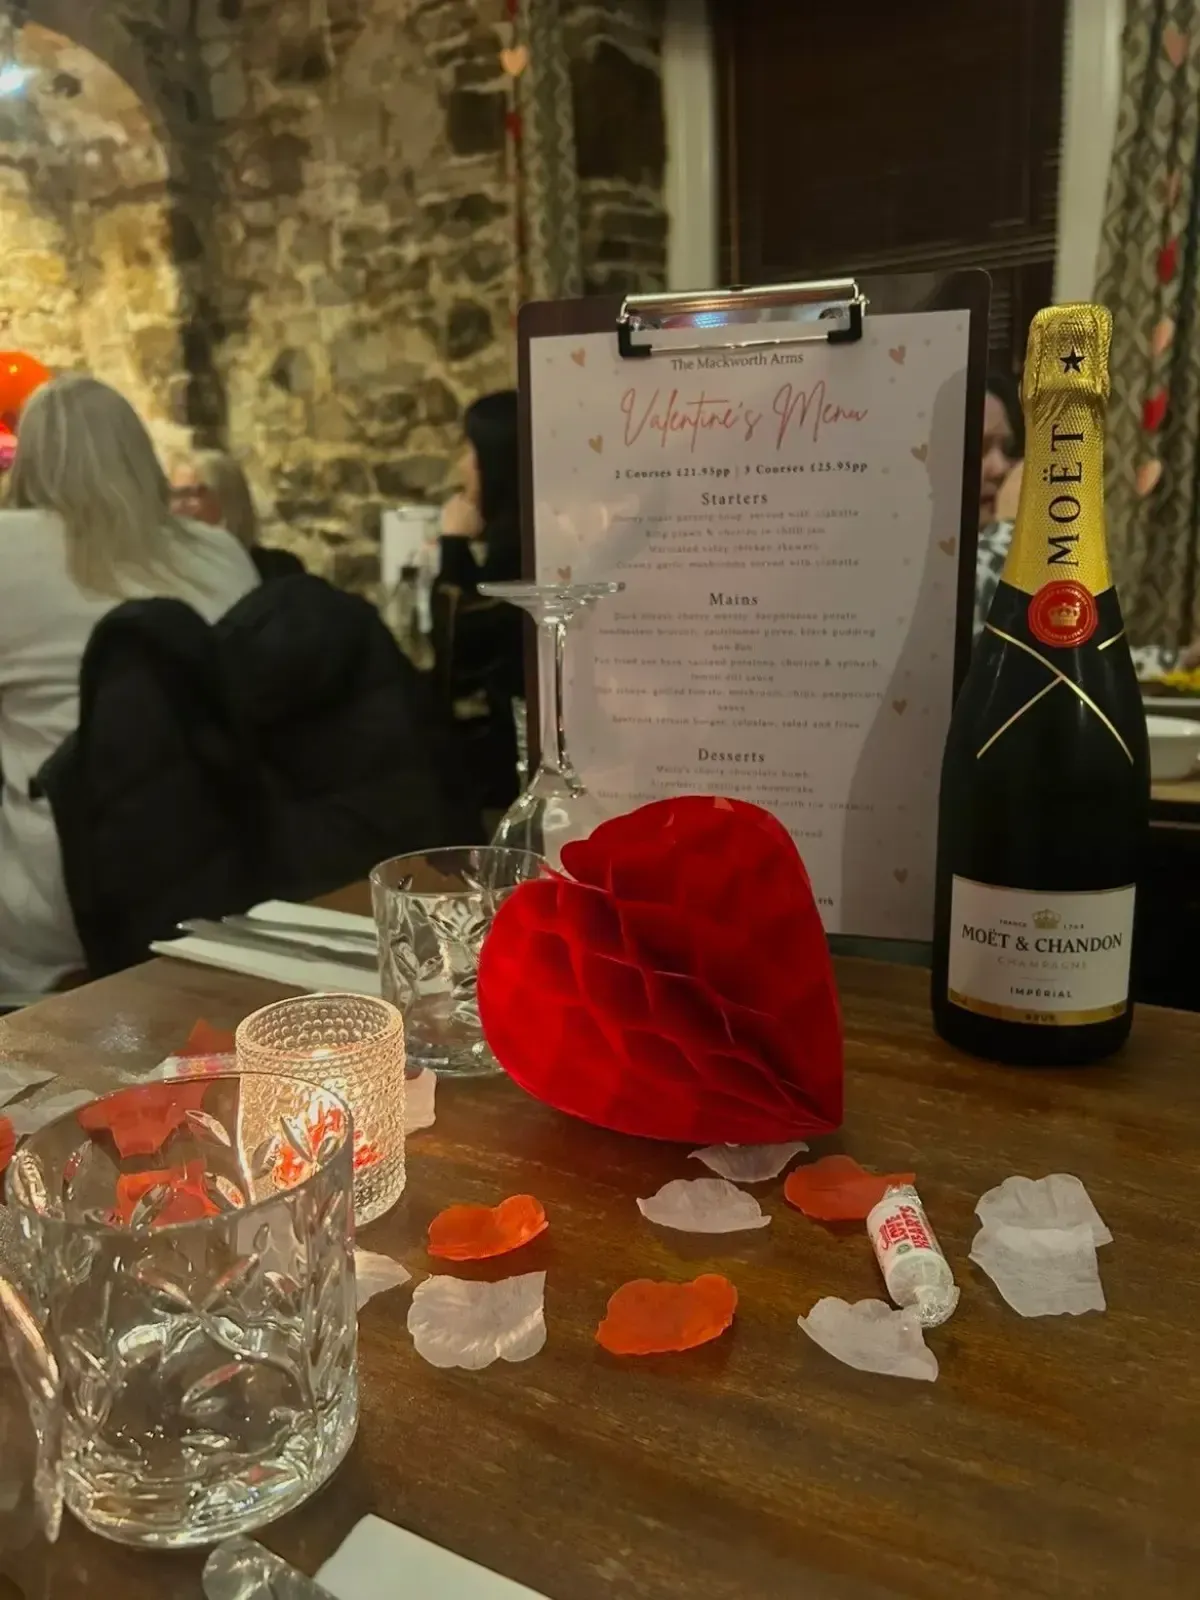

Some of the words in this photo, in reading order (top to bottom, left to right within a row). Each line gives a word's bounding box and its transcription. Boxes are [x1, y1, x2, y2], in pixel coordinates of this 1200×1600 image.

[671, 358, 694, 372] The
[697, 355, 768, 370] Mackworth
[770, 352, 804, 366] Arms
[620, 387, 763, 453] Valentine's
[773, 380, 869, 450] Menu
[625, 467, 672, 479] Courses
[756, 463, 804, 475] Courses
[701, 491, 769, 506] Starters
[1043, 424, 1085, 567] MOËT
[709, 592, 759, 606] Mains
[697, 748, 766, 763] Desserts
[999, 918, 1028, 928] FRANCE
[962, 923, 1011, 949] MOËT
[1015, 935, 1030, 952] &
[1035, 932, 1123, 954] CHANDON
[996, 956, 1088, 971] CHAMPAGNE
[1010, 985, 1073, 999] IMPÉRIAL
